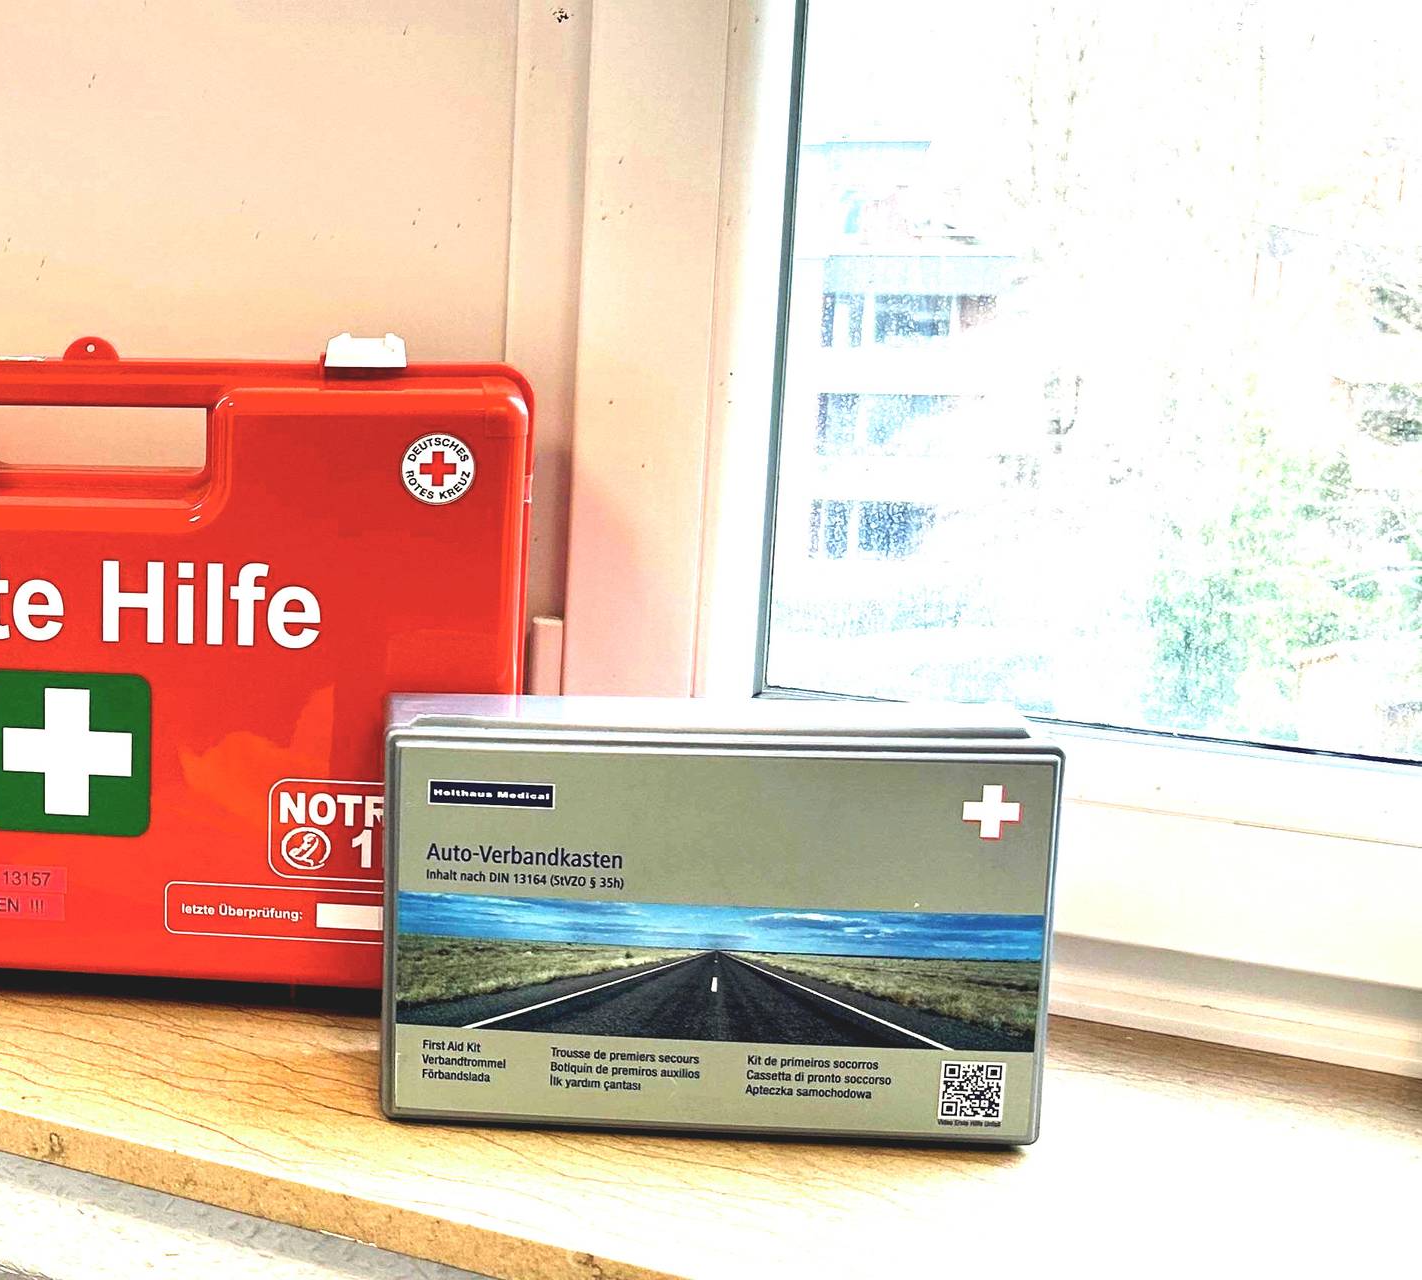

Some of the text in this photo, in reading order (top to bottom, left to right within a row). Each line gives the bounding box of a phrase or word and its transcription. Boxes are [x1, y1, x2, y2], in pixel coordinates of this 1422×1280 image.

[407, 437, 470, 463] DEUTSCHES
[405, 470, 471, 500] ROTES KREUZ
[101, 559, 322, 650] Hilfe
[497, 791, 550, 801] Medical
[279, 791, 384, 828] NOTR
[426, 842, 623, 869] Auto-Verbandkasten
[2, 871, 51, 887] 13157
[426, 869, 625, 890] Inhalt nach DIN 13164 (StVZO § 35h)
[181, 903, 303, 922] letzte Überprüfung:
[422, 1039, 481, 1053] First Aid Kit
[422, 1054, 506, 1069] Verbandtrommel
[551, 1046, 700, 1065] Trousse de premiers secours
[747, 1054, 879, 1070] Kit de primeiros socorros
[422, 1068, 491, 1083] Förbandslada
[596, 1064, 609, 1074] de
[660, 1068, 700, 1079] auxilios
[746, 1069, 892, 1086] Cassetta di pronto soccorso
[745, 1084, 872, 1100] Apteczka samochodowa
